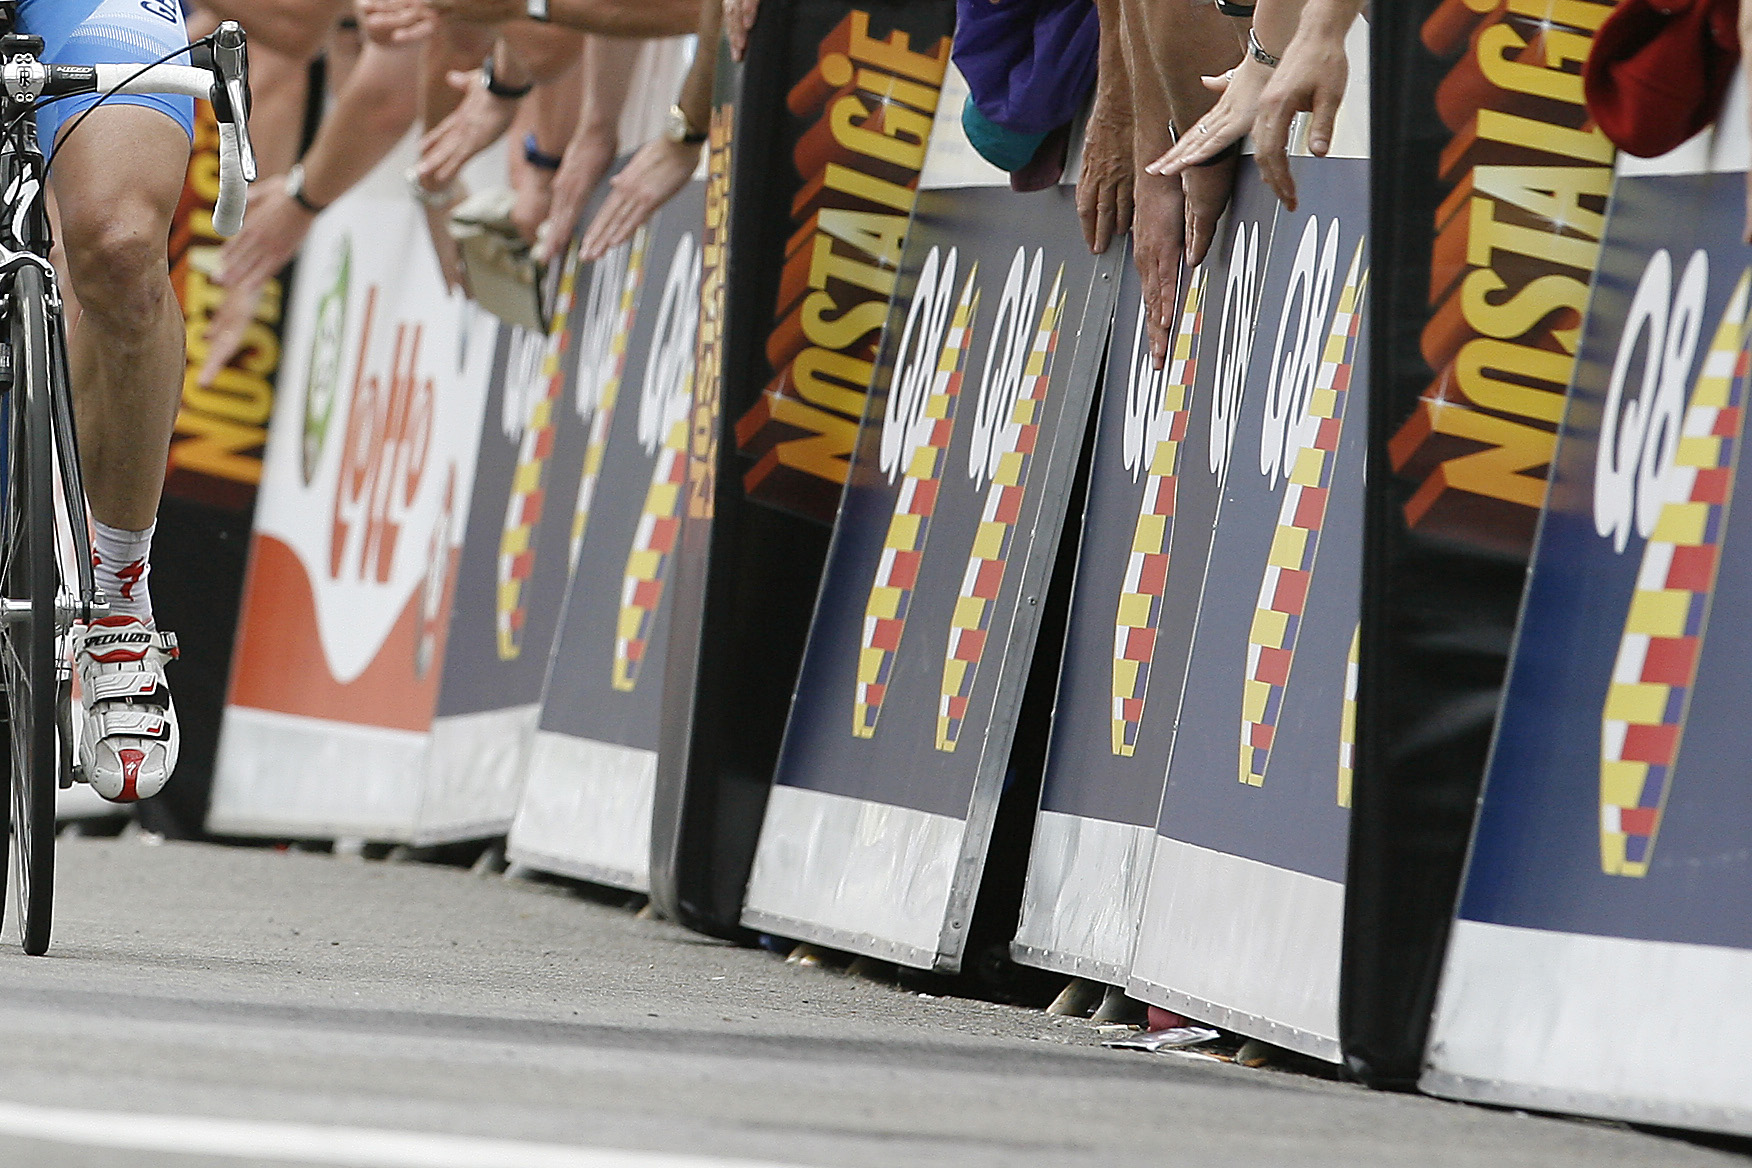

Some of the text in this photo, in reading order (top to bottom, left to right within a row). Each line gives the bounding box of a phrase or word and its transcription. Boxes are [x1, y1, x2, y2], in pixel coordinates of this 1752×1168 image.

[879, 245, 959, 486] Q8
[968, 245, 1044, 493] Q8
[1260, 214, 1340, 491] Q8
[1594, 248, 1709, 554] Q8
[83, 633, 152, 649] SPECIALIZED
